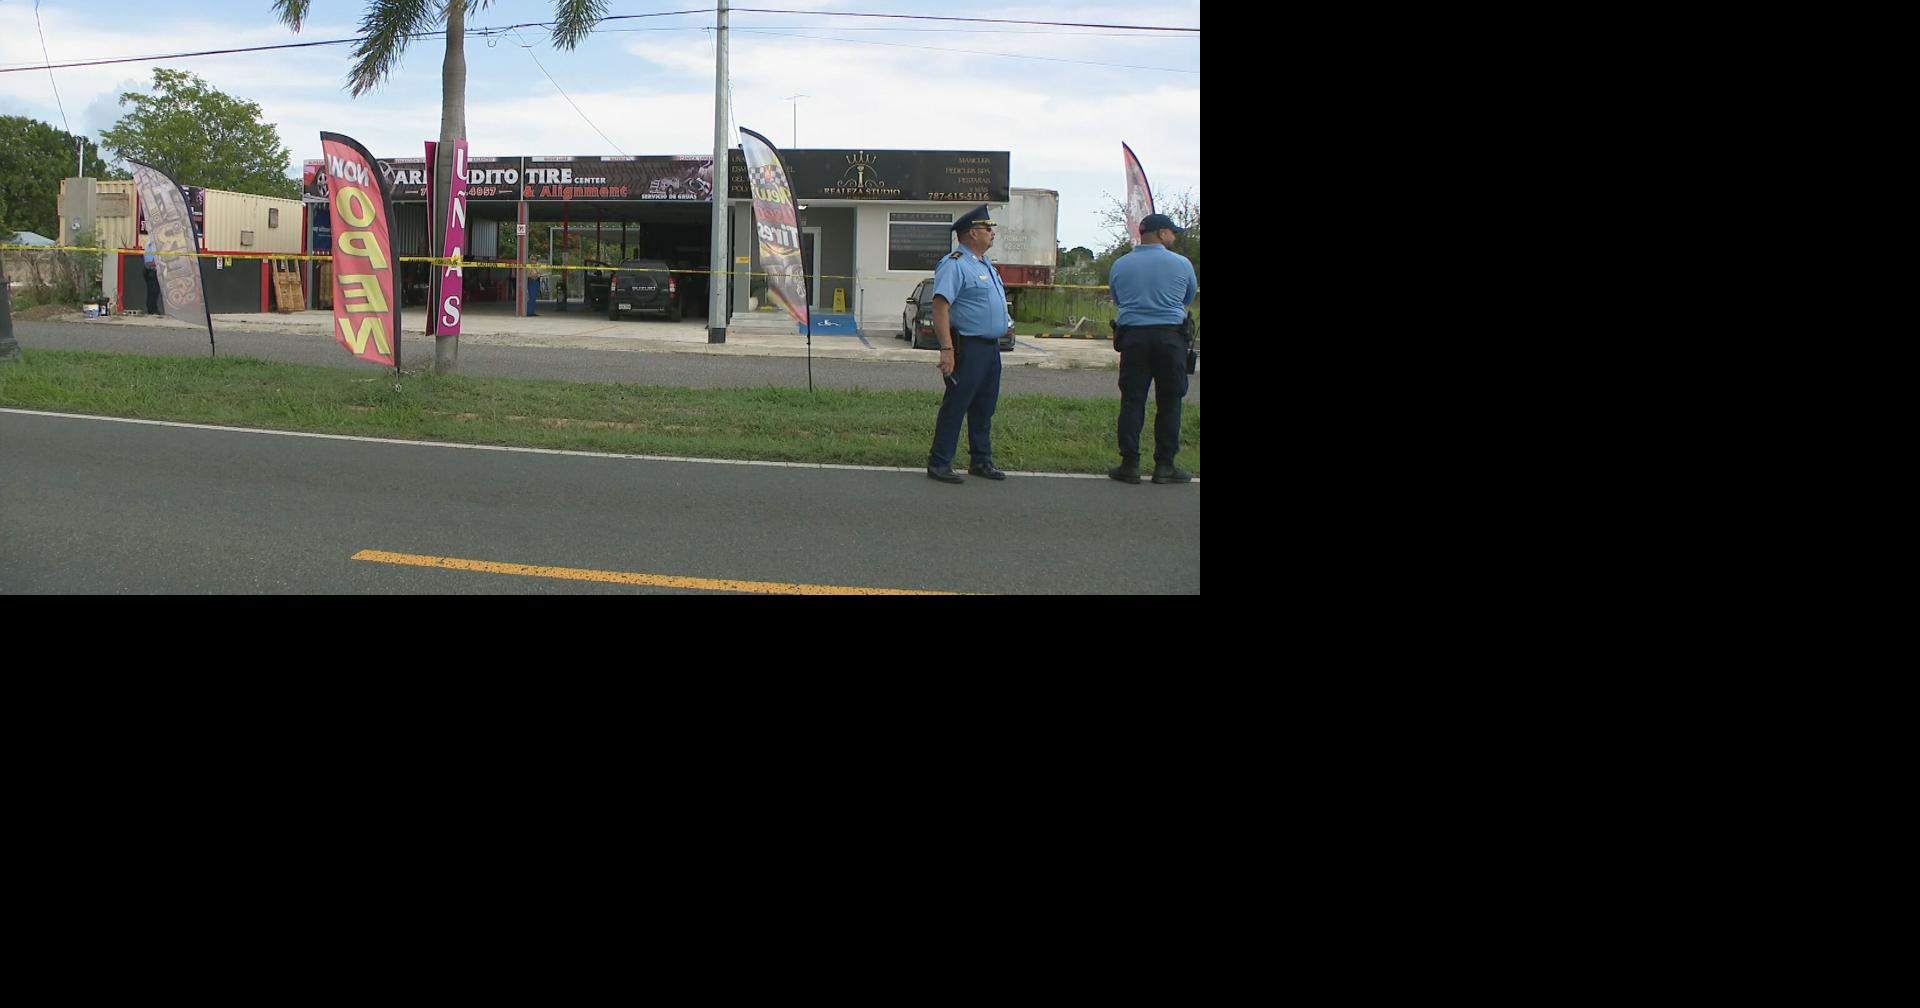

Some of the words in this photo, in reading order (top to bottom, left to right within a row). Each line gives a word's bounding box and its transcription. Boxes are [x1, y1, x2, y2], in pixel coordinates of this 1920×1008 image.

[394, 169, 519, 185] ARDITO
[525, 168, 572, 184] TIRE
[523, 185, 535, 197] &
[540, 184, 628, 200] Alignment
[865, 187, 901, 195] STUDIO
[928, 192, 990, 200] 787-615-5116
